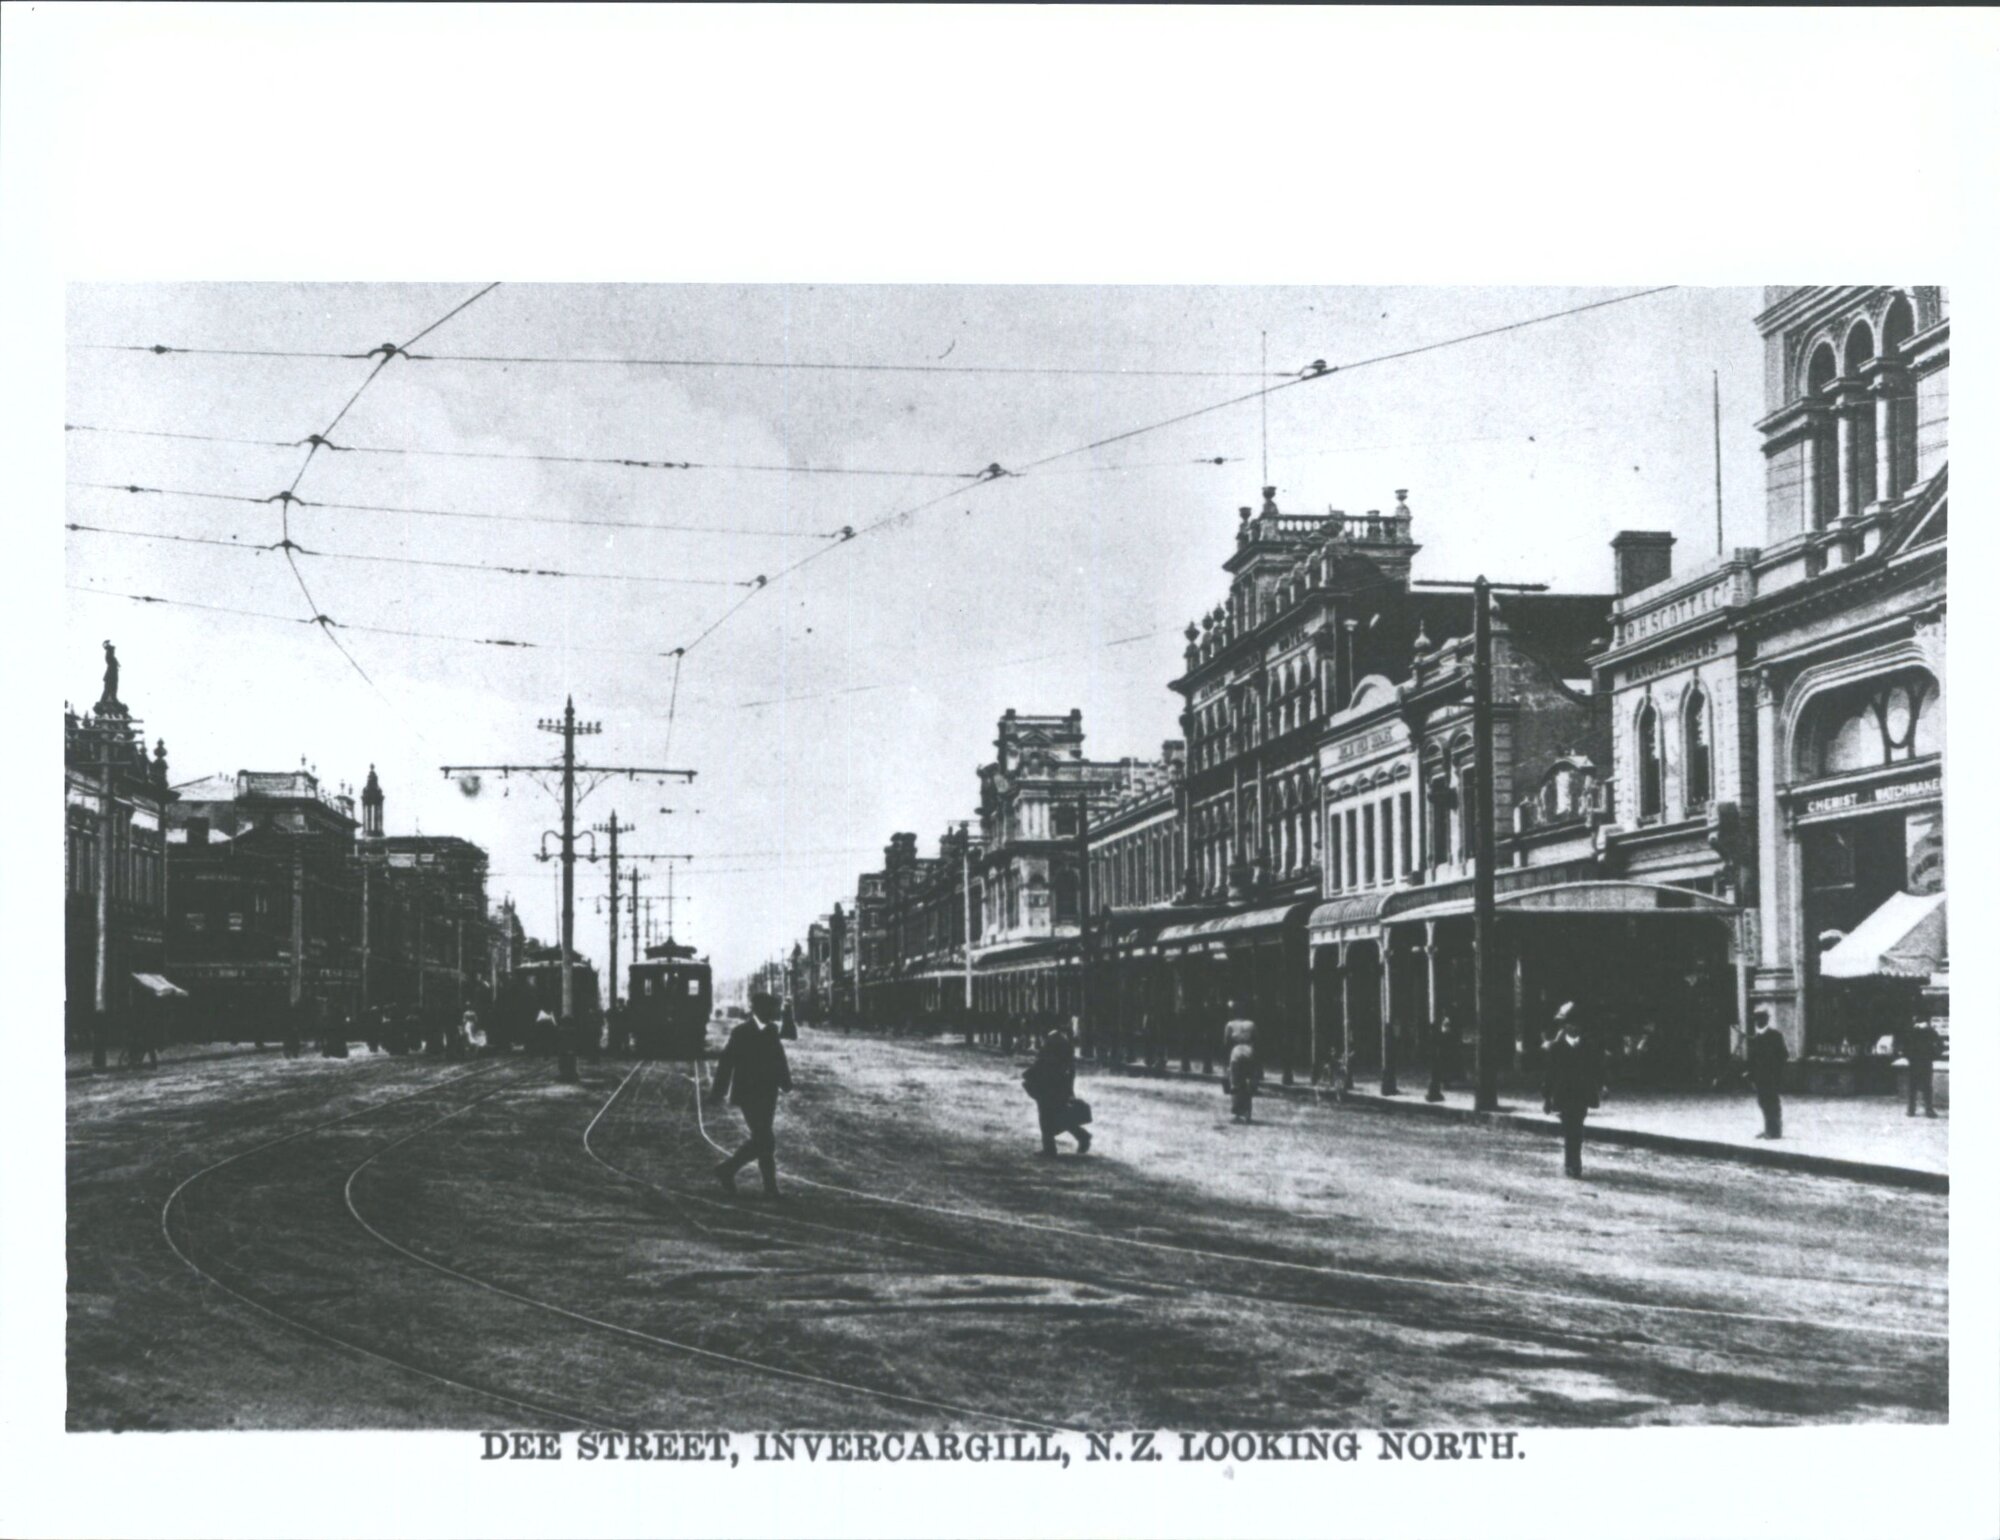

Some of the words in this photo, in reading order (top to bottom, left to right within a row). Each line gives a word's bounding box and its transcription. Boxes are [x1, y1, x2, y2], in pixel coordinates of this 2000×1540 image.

[1650, 595, 1697, 635] SCOTT
[1625, 637, 1719, 683] MANUFACTURERS
[1807, 792, 1859, 813] CHEMIST
